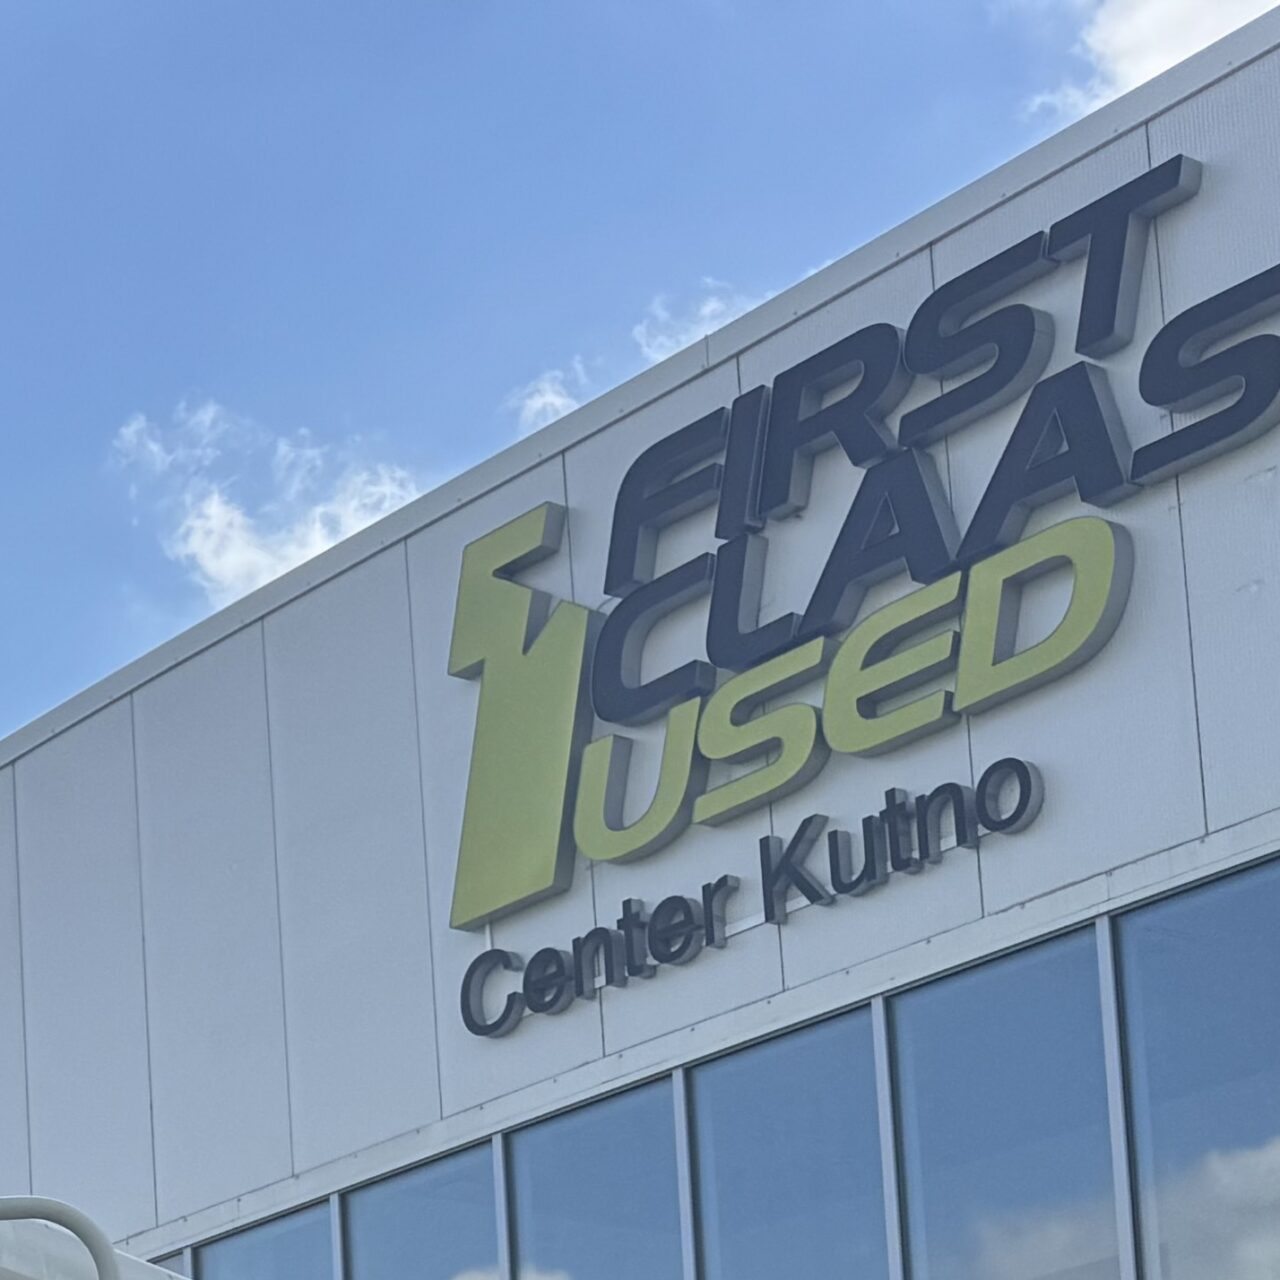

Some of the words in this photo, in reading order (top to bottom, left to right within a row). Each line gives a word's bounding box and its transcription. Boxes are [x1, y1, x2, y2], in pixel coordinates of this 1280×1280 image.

[591, 261, 1280, 726] CLAAS
[602, 154, 1202, 598] FIRST
[572, 515, 1134, 862] USED
[460, 873, 738, 1038] Center
[758, 757, 1044, 924] Kutno
